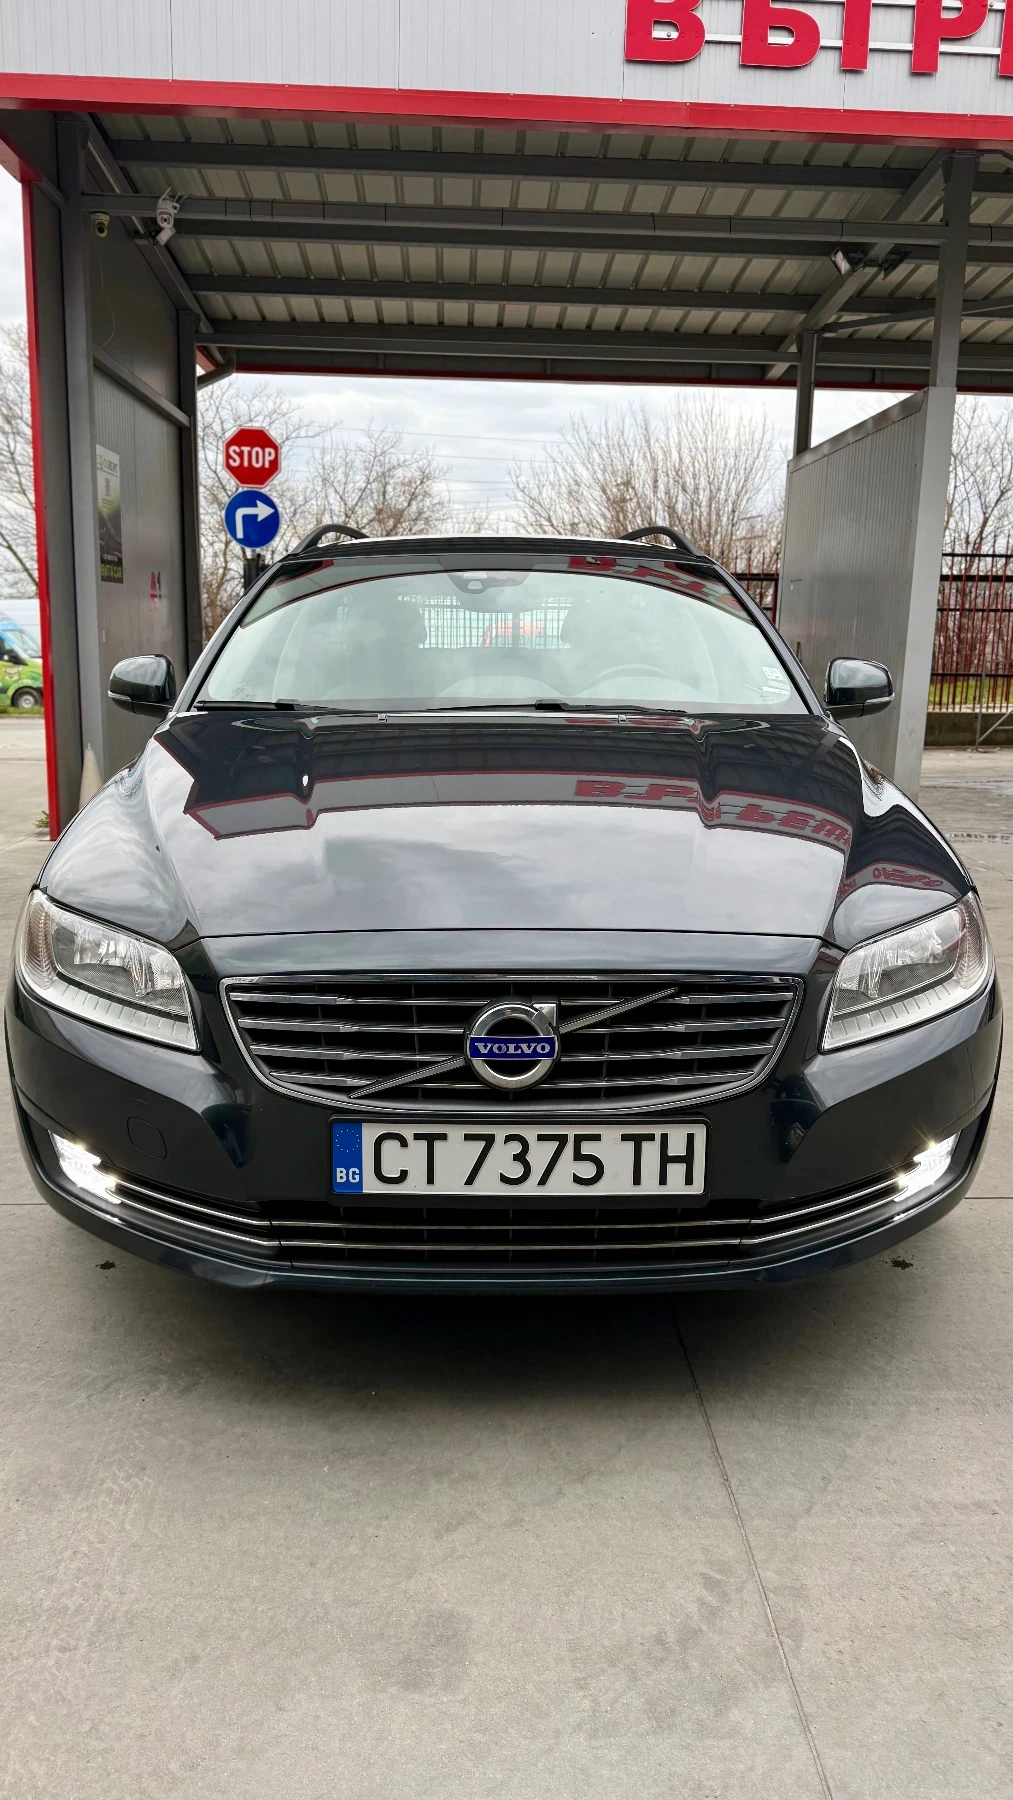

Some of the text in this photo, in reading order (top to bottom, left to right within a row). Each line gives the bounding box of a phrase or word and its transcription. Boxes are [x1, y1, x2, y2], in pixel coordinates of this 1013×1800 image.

[228, 445, 276, 469] STOP
[474, 1042, 551, 1055] VOLVO
[373, 1131, 695, 1187] CT 7375 TH
[335, 1167, 360, 1183] BG
